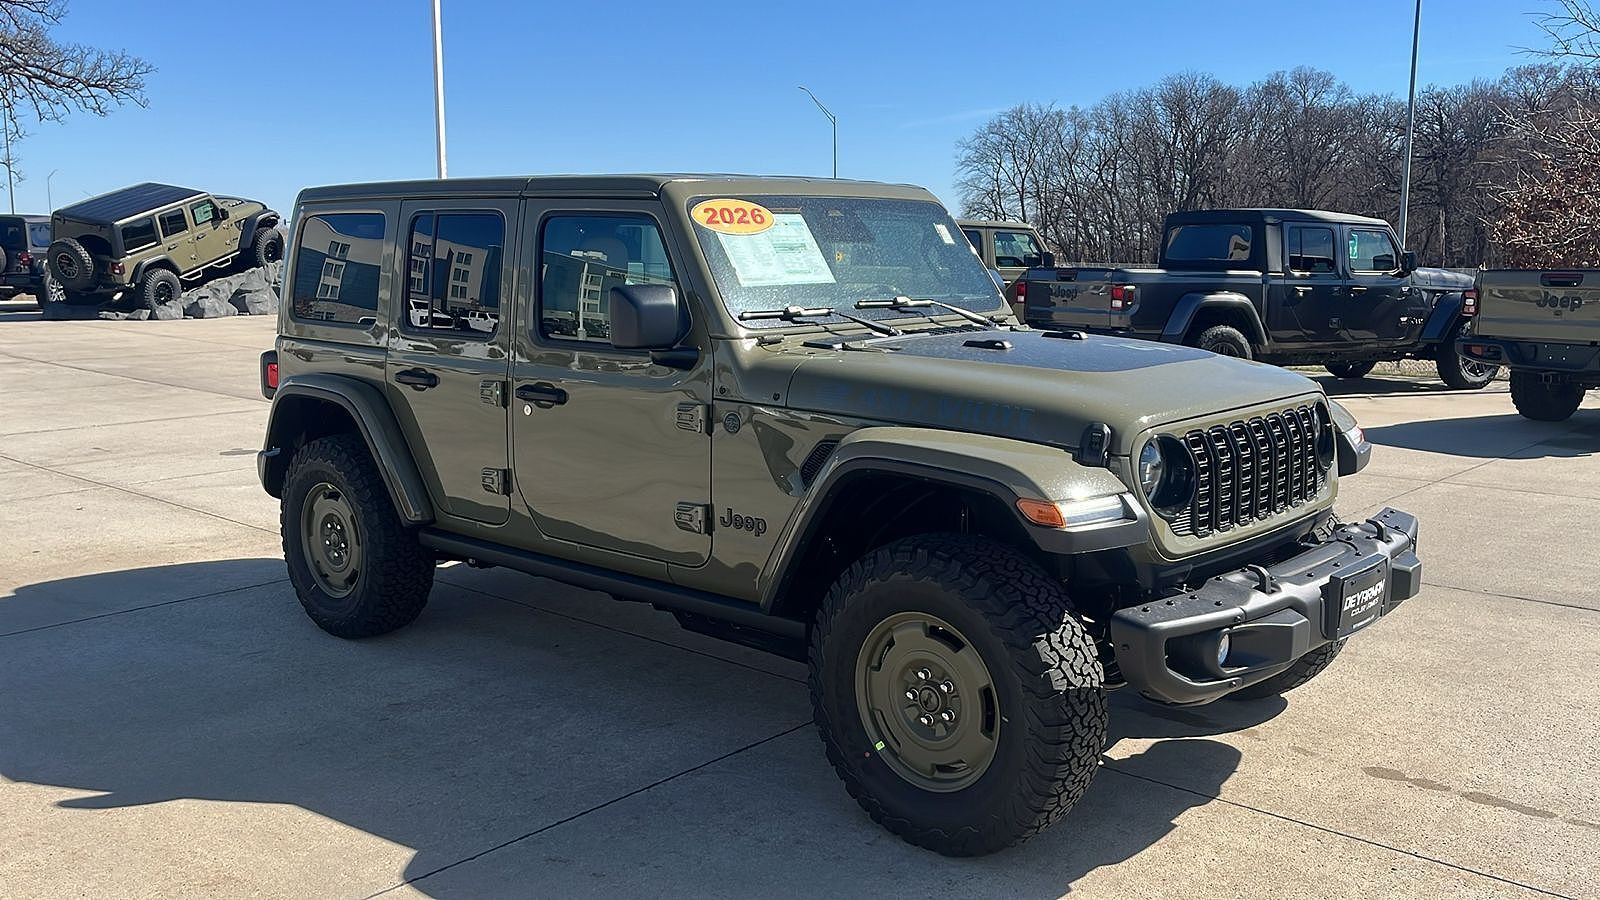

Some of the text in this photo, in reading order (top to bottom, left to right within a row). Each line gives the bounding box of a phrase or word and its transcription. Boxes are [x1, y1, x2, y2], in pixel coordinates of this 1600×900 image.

[703, 207, 766, 225] 2026
[1054, 285, 1078, 301] Jeep
[1535, 291, 1583, 312] Jeep
[719, 508, 767, 537] Jeep
[1343, 578, 1386, 612] DEYARMAN
